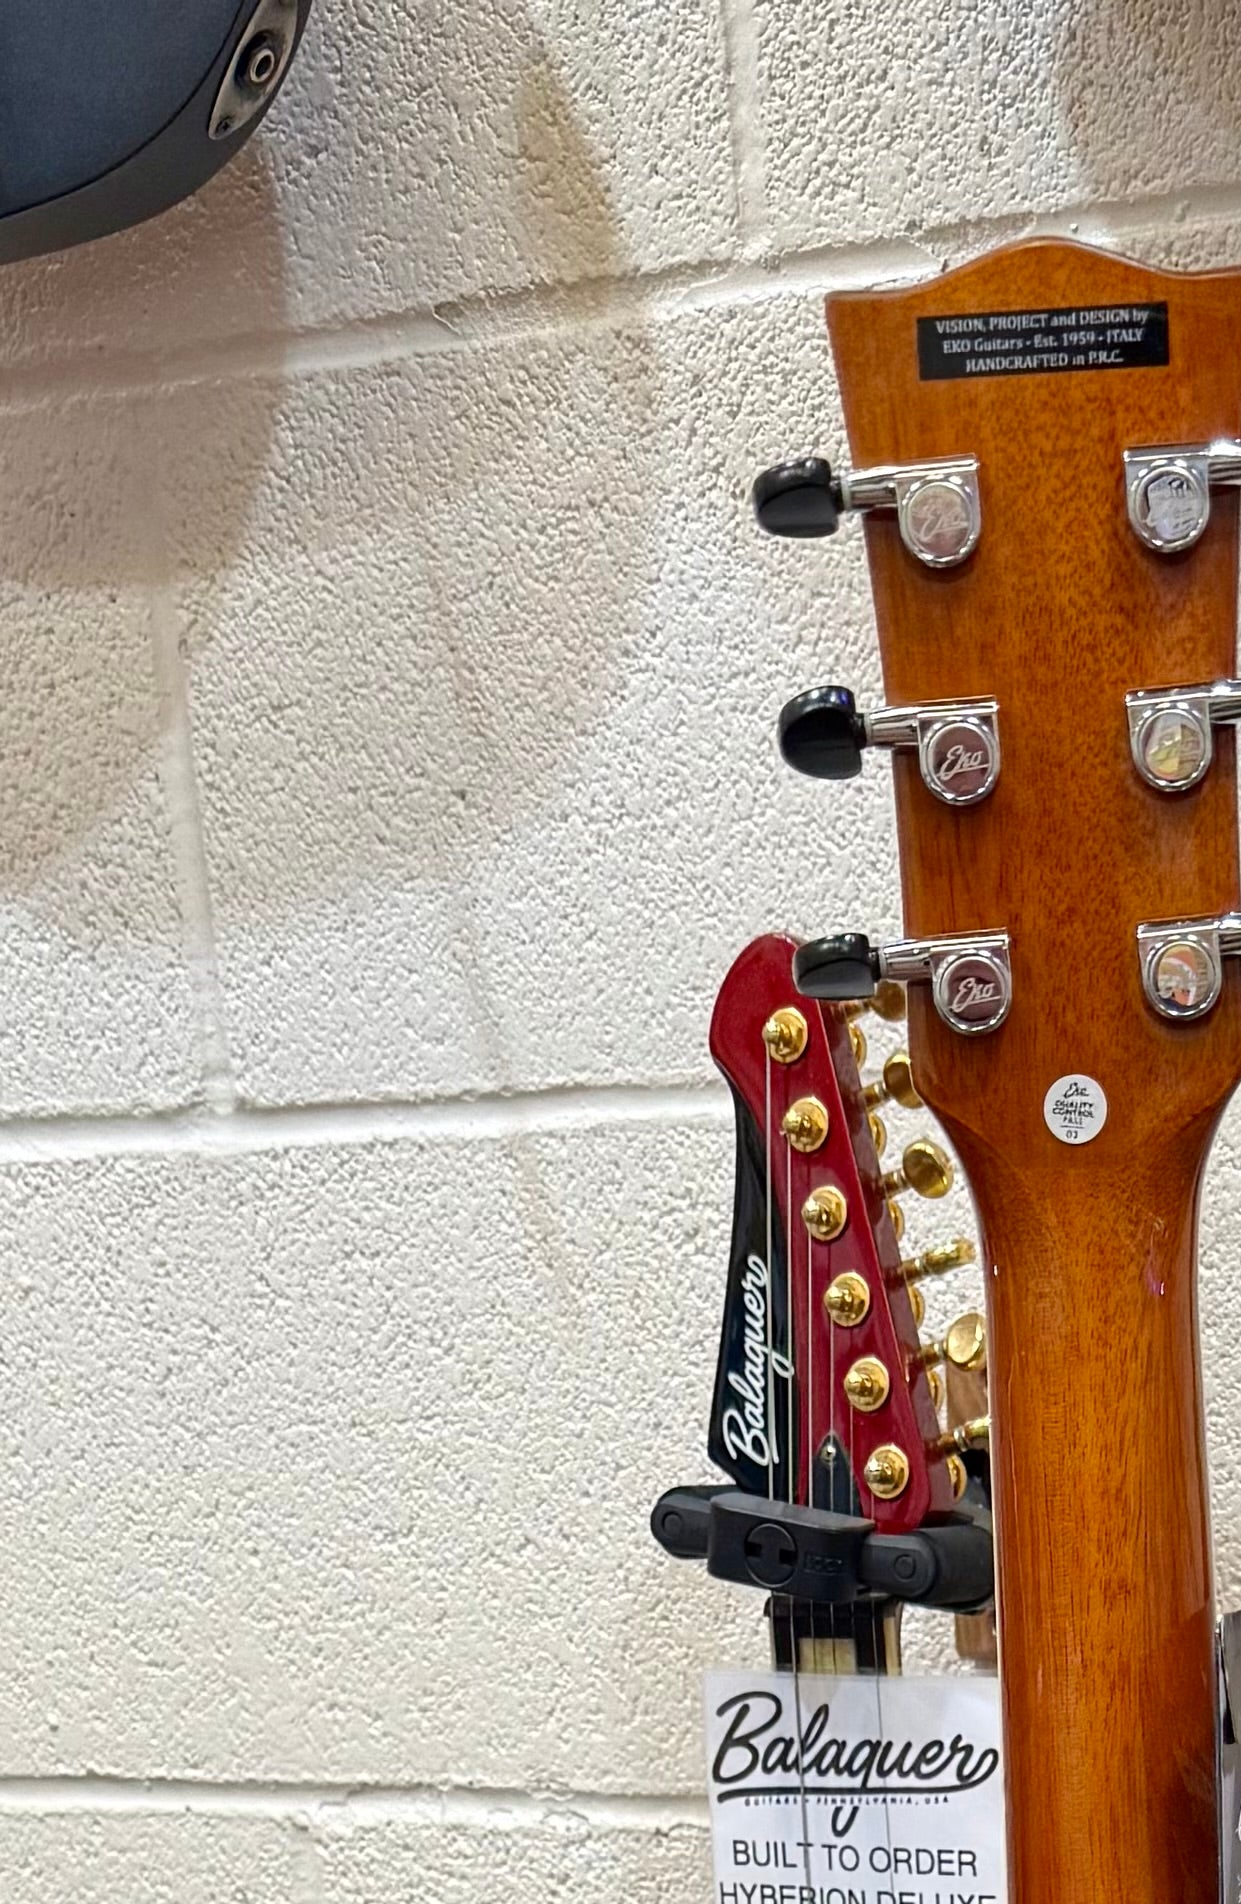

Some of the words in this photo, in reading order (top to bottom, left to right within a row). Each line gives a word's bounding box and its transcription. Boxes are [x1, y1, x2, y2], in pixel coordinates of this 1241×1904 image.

[935, 319, 987, 334] VISION,
[989, 313, 1049, 332] PROJECT
[1050, 311, 1076, 327] and
[1079, 308, 1130, 325] DESIGN
[1132, 308, 1150, 325] by
[943, 339, 972, 354] EKO
[973, 335, 1024, 352] Guitars
[1033, 334, 1058, 349] Est.
[1062, 331, 1096, 347] 1959
[1106, 327, 1145, 344] ITALY
[965, 352, 1069, 374] HANDCRAFTED
[936, 744, 990, 781] Eko
[949, 976, 1001, 1013] Eko
[732, 1839, 814, 1868] BUILT
[821, 1843, 860, 1872] TO
[869, 1846, 978, 1877] ORDER
